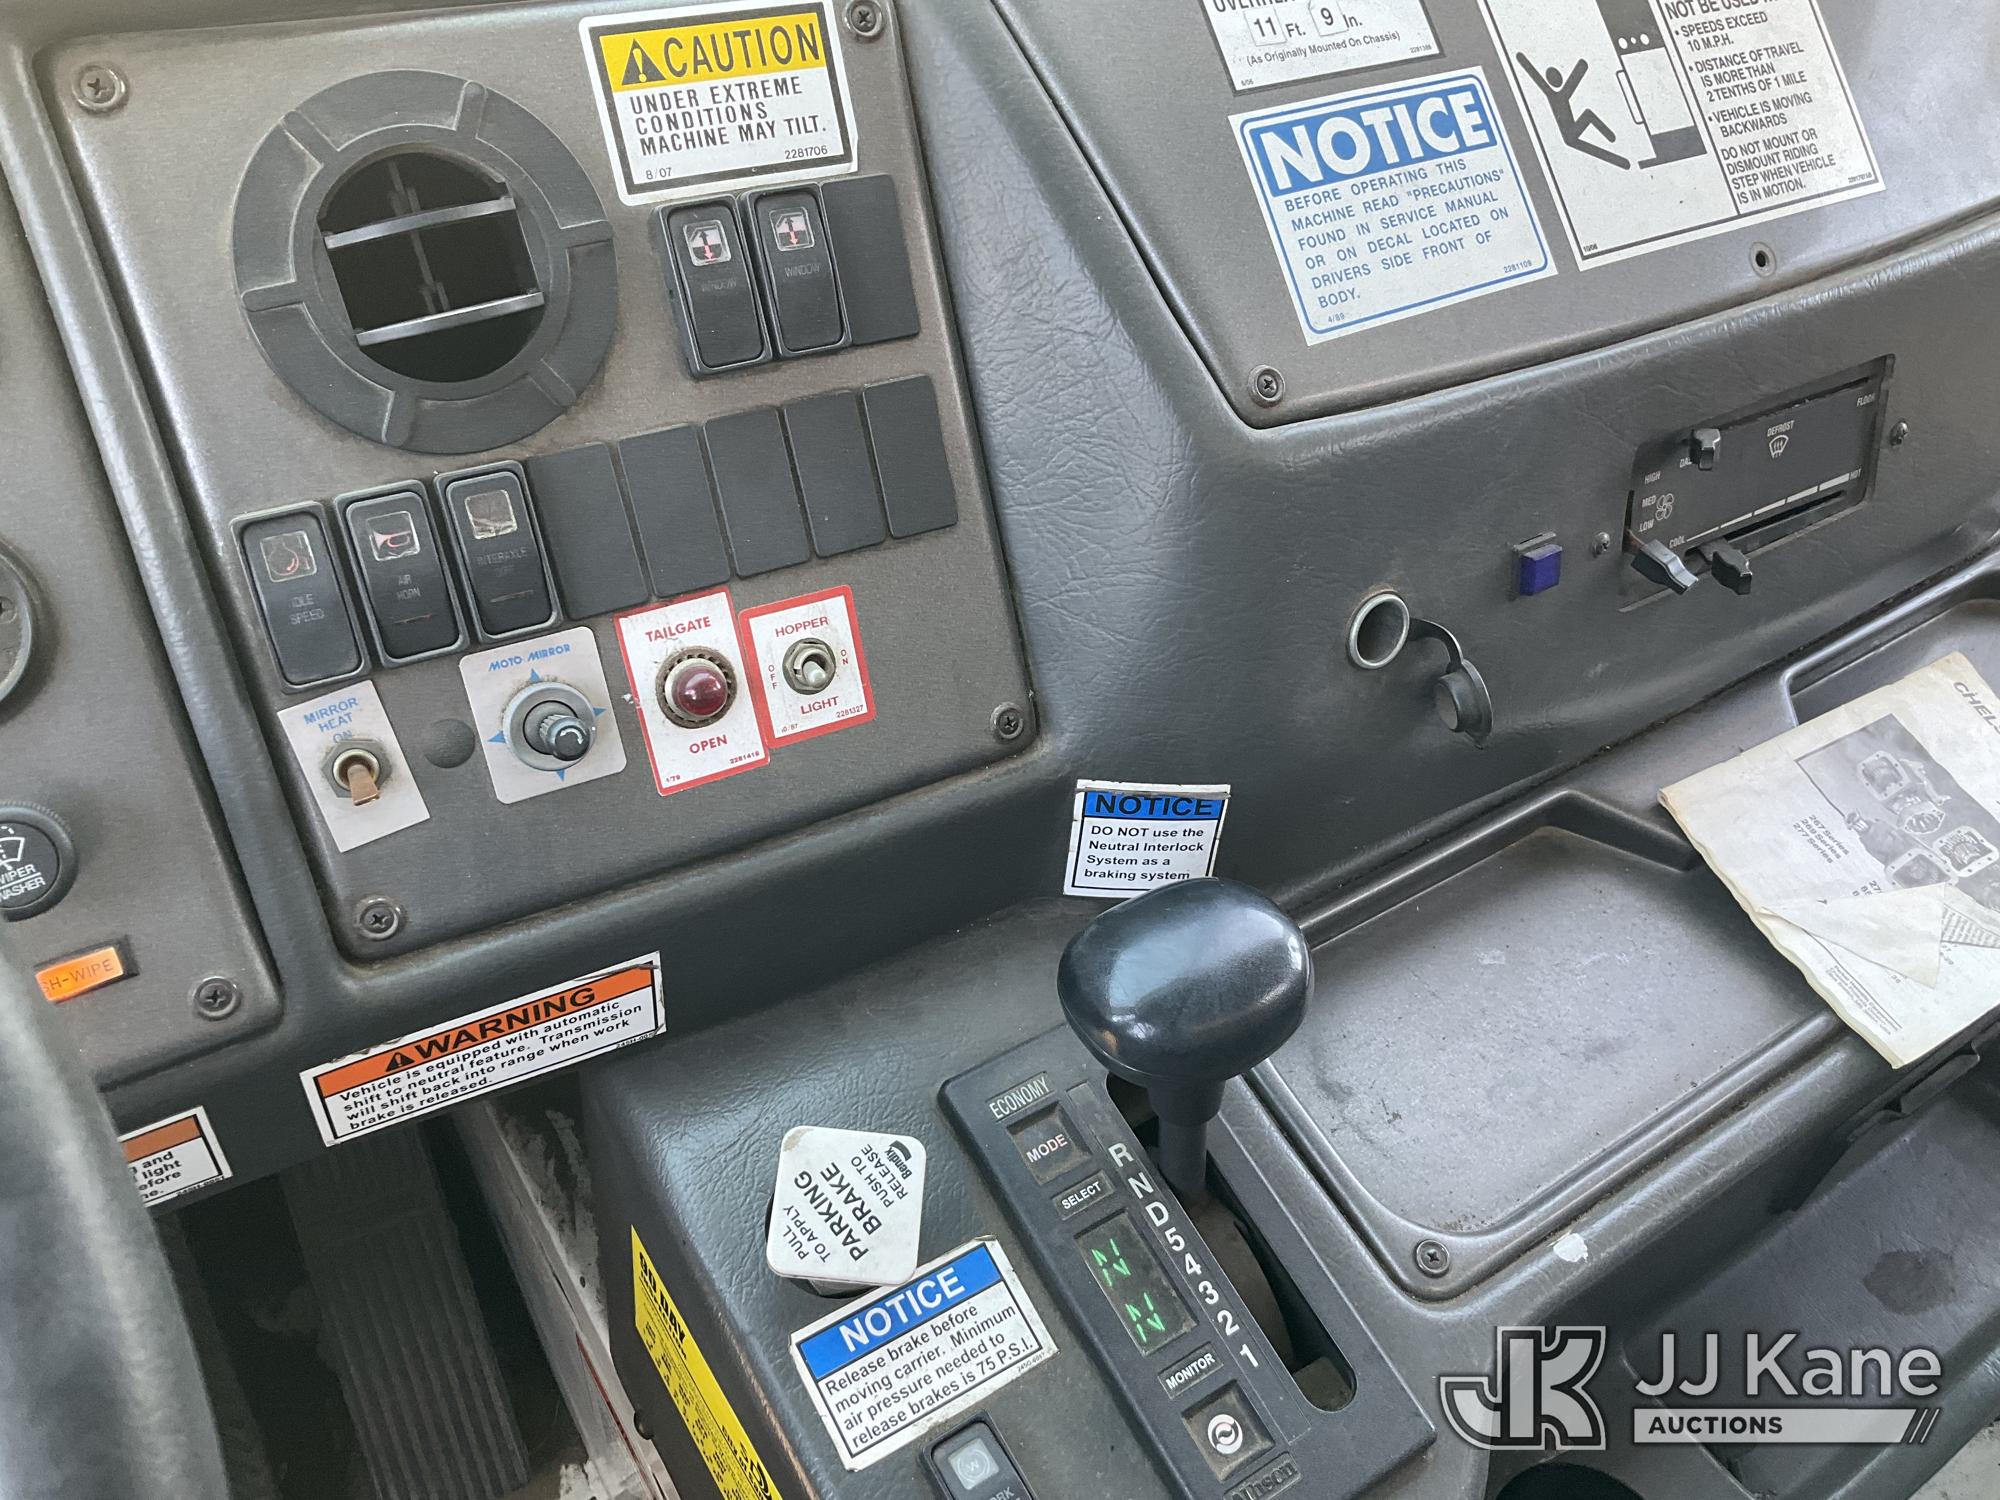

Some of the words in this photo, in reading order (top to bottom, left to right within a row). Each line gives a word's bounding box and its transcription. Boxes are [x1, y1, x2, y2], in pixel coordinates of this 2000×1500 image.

[1254, 17, 1278, 38] 11
[1285, 23, 1306, 38] Ft.
[1320, 8, 1334, 26] 9
[1343, 14, 1363, 28] In.
[1681, 19, 1725, 38] SPEEDS
[1726, 11, 1768, 29] EXCEED
[664, 23, 820, 78] CAUTION
[1247, 54, 1263, 67] (As
[1265, 43, 1307, 63] Originally
[1309, 39, 1347, 54] Mounted
[1349, 37, 1362, 47] On
[1364, 30, 1400, 45] Chassis)
[1687, 40, 1700, 52] 10
[1702, 33, 1734, 49] M.P.H.
[1694, 52, 1748, 73] DISTANCE
[1750, 49, 1765, 61] OF
[1764, 41, 1804, 57] TRAVEL
[630, 89, 699, 114] UNDER
[712, 76, 802, 105] EXTREME
[635, 102, 768, 135] CONDITIONS
[1720, 113, 1788, 137] BACKWARDS
[640, 127, 730, 156] MACHINE
[739, 121, 776, 141] MAY
[784, 115, 826, 136] TILT.
[1260, 91, 1490, 190] NOTICE
[785, 146, 828, 159] 2281706
[1726, 152, 1782, 175] DISMOUNT
[1784, 143, 1819, 161] RIDING
[1285, 187, 1342, 213] BEFORE
[1351, 168, 1428, 197] OPERATING
[1436, 158, 1467, 175] THIS
[1732, 175, 1759, 190] STEP
[1760, 165, 1796, 182] WHEN
[1794, 154, 1836, 174] VEHICLE
[1291, 207, 1356, 232] MACHINE
[1364, 195, 1399, 214] READ
[1406, 169, 1504, 199] "PRECAUTIONS"
[1311, 264, 1371, 289] DRIVERS
[1382, 254, 1413, 271] SIDE
[1423, 237, 1465, 261] FRONT
[1476, 230, 1493, 245] OF
[1318, 289, 1361, 309] BODY.
[1767, 420, 1794, 437] DEFROST
[1644, 471, 1661, 484] HIGH
[1642, 495, 1656, 508] MED
[1640, 519, 1654, 532] LOW
[645, 616, 711, 642] TAILGATE
[775, 616, 828, 637] HOPPER
[488, 656, 522, 671] MOTO
[527, 644, 571, 663] MIRROR
[304, 697, 358, 726] MIRROR
[801, 696, 839, 715] LIGHT
[319, 713, 353, 732] HEAT
[689, 735, 728, 754] OPEN
[1096, 794, 1212, 816] NOTICE
[1091, 826, 1113, 835] DO
[1118, 828, 1149, 837] NOT
[1183, 829, 1204, 837] the
[1823, 830, 1849, 855] Series
[1089, 841, 1139, 851] Neutral
[1143, 843, 1204, 851] Interlock
[1808, 838, 1833, 863] Series
[1815, 833, 1841, 859] Series
[1087, 855, 1138, 865] System
[1084, 869, 1136, 881] braking
[414, 987, 596, 1060] WARNING
[339, 1076, 401, 1102] Vehicle
[406, 1069, 421, 1080] is
[426, 1041, 500, 1074] equipped
[505, 1028, 539, 1045] with
[544, 1001, 620, 1033] automatic
[343, 1094, 383, 1111] shift
[386, 1086, 403, 1097] to
[407, 1064, 465, 1090] neutral
[468, 1044, 531, 1070] feature.
[538, 1004, 642, 1045] Transmission
[989, 1075, 1051, 1119] ECONOMY
[142, 1151, 173, 1168] and
[1026, 1134, 1067, 1163] MODE
[1108, 1142, 1134, 1167] R
[142, 1160, 181, 1179] light
[851, 1156, 867, 1175] TO
[861, 1144, 908, 1200] RELEASE
[884, 1148, 913, 1179] Bendix
[139, 1171, 181, 1190] efore
[864, 1173, 894, 1208] PUSH
[1127, 1172, 1153, 1199] N
[820, 1162, 882, 1235] BRAKE
[1062, 1182, 1101, 1210] SELECT
[783, 1205, 818, 1242] APPLY
[794, 1171, 869, 1261] PARKING
[1145, 1201, 1168, 1227] D
[783, 1225, 809, 1260] PULL
[1165, 1227, 1185, 1251] 5
[814, 1243, 831, 1263] TO
[1183, 1253, 1201, 1276] 4
[1199, 1281, 1219, 1304] 3
[838, 1267, 965, 1352] NOTICE
[1217, 1310, 1239, 1336] 2
[825, 1355, 886, 1395] Release
[888, 1331, 930, 1362] brake
[930, 1304, 978, 1335] before
[835, 1375, 893, 1414] moving
[894, 1350, 946, 1378] carrier.
[950, 1305, 1017, 1348] Minimum
[1240, 1343, 1258, 1368] 1
[844, 1410, 864, 1430] air
[867, 1373, 933, 1420] pressure
[936, 1342, 988, 1378] needed
[989, 1333, 1005, 1350] to
[1165, 1353, 1215, 1389] MONITOR
[852, 1410, 907, 1448] release
[911, 1382, 959, 1415] brakes
[962, 1369, 976, 1385] is
[977, 1357, 995, 1376] 75
[996, 1338, 1033, 1368] P.S.I.
